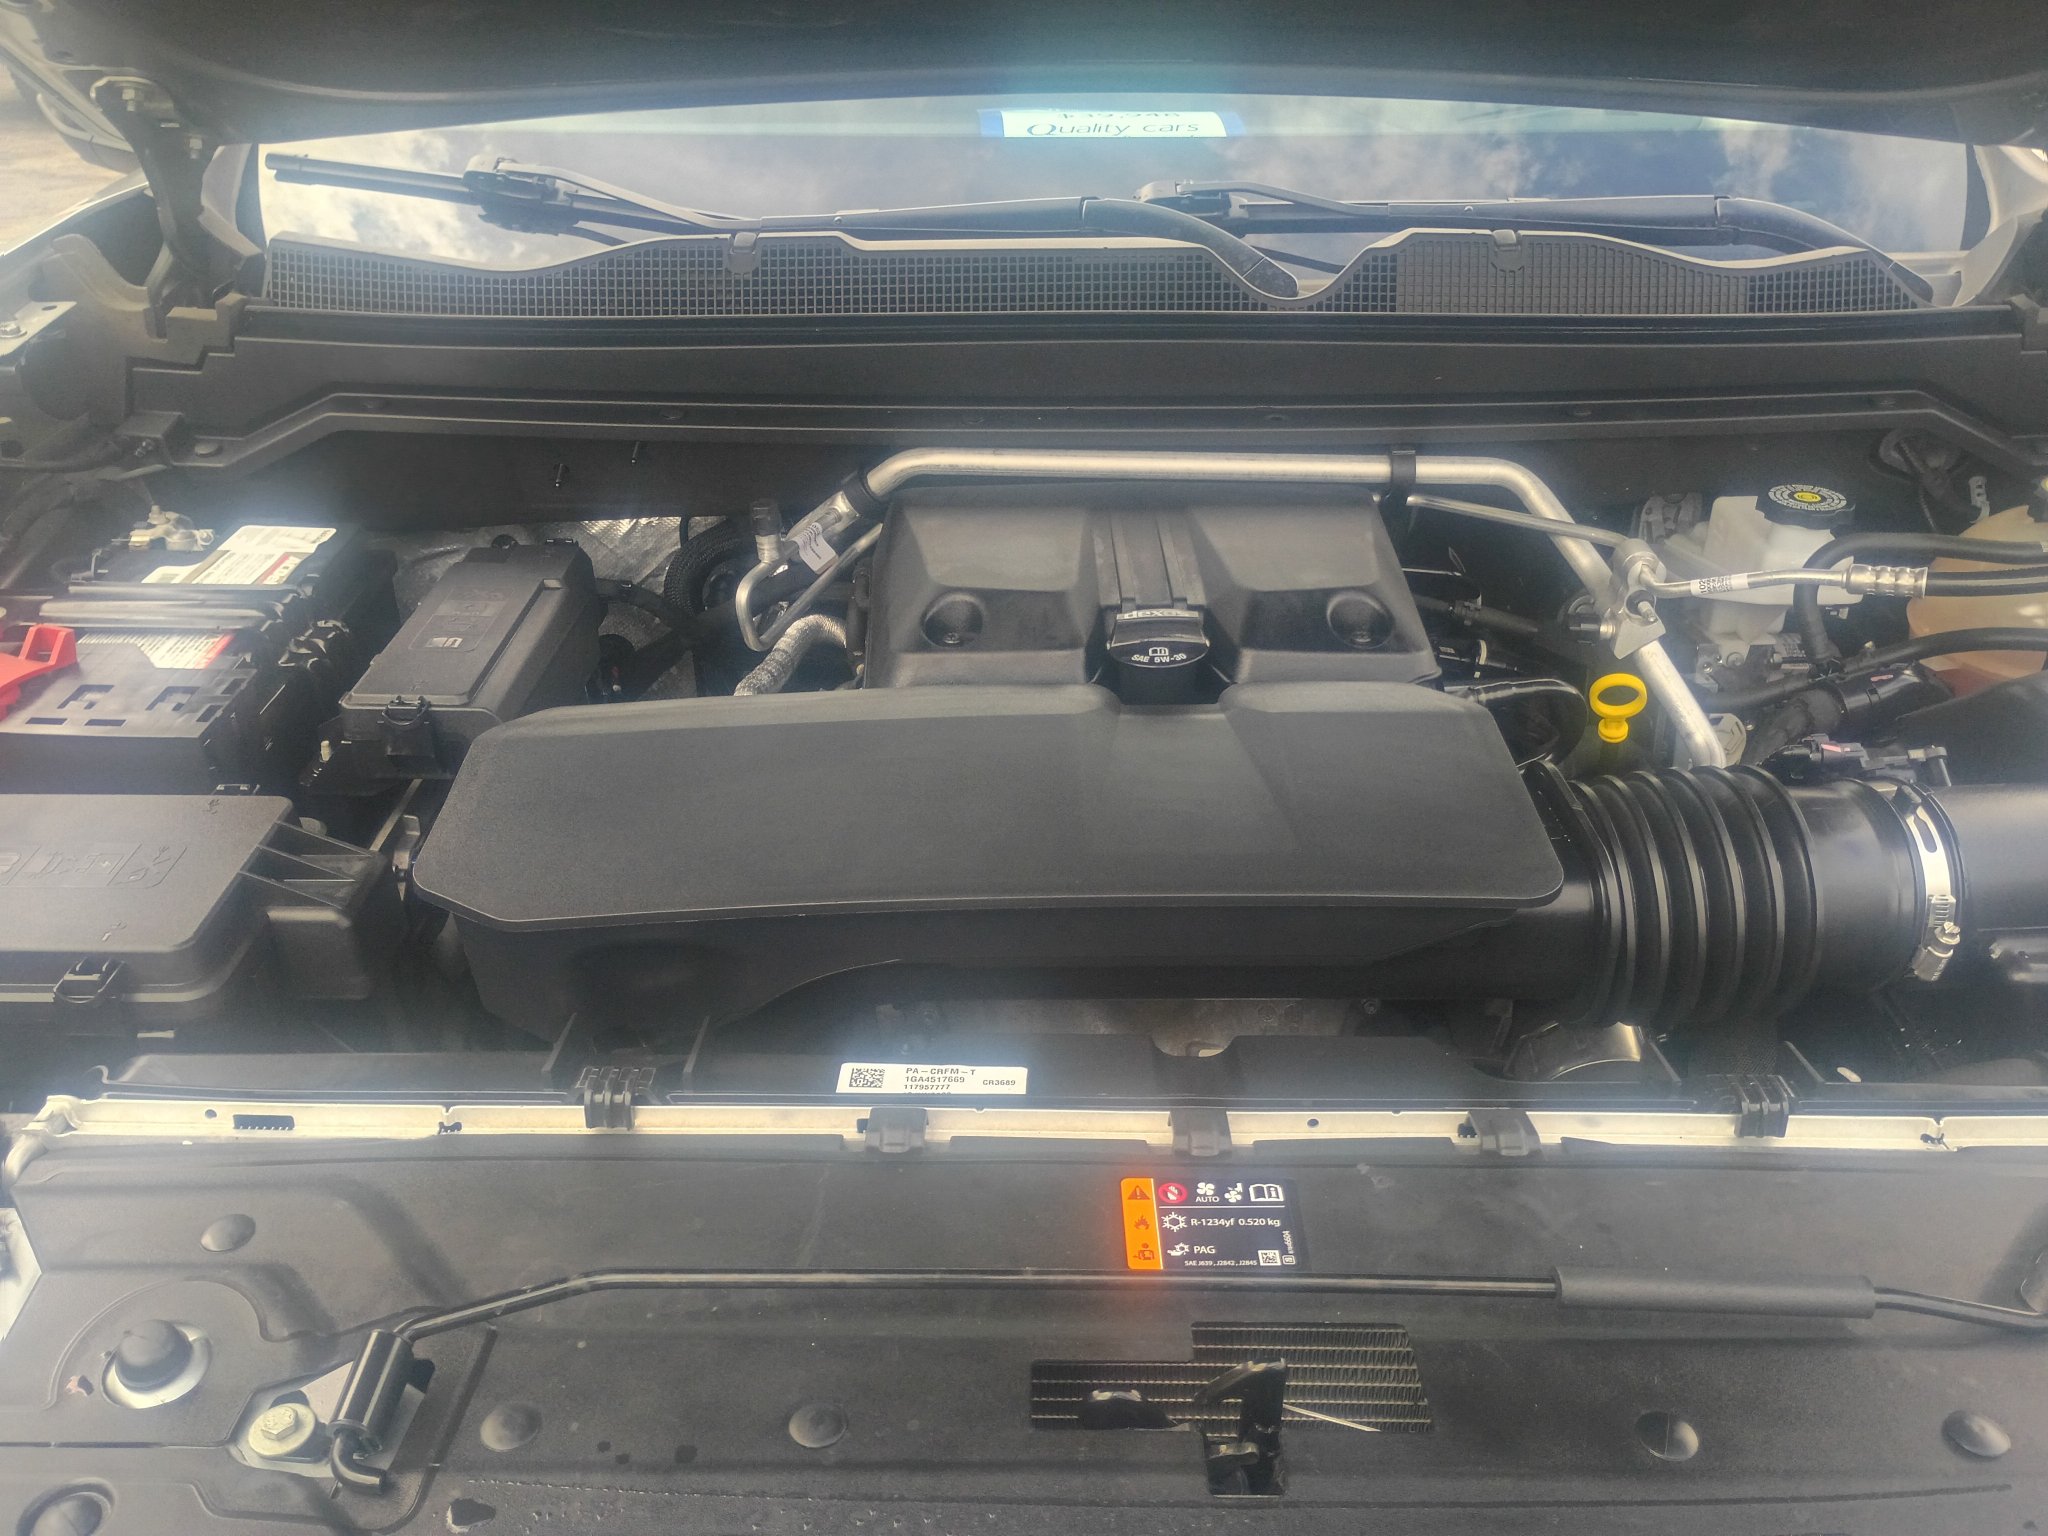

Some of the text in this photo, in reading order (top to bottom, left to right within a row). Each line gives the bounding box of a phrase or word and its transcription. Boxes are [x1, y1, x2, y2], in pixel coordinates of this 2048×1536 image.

[1027, 122, 1199, 136] Quality cars
[1131, 653, 1186, 662] SAE 5W-30
[1195, 1195, 1220, 1203] AUTO
[1191, 1218, 1280, 1228] R-1234yf 0.520 kg
[1193, 1245, 1216, 1254] PAG
